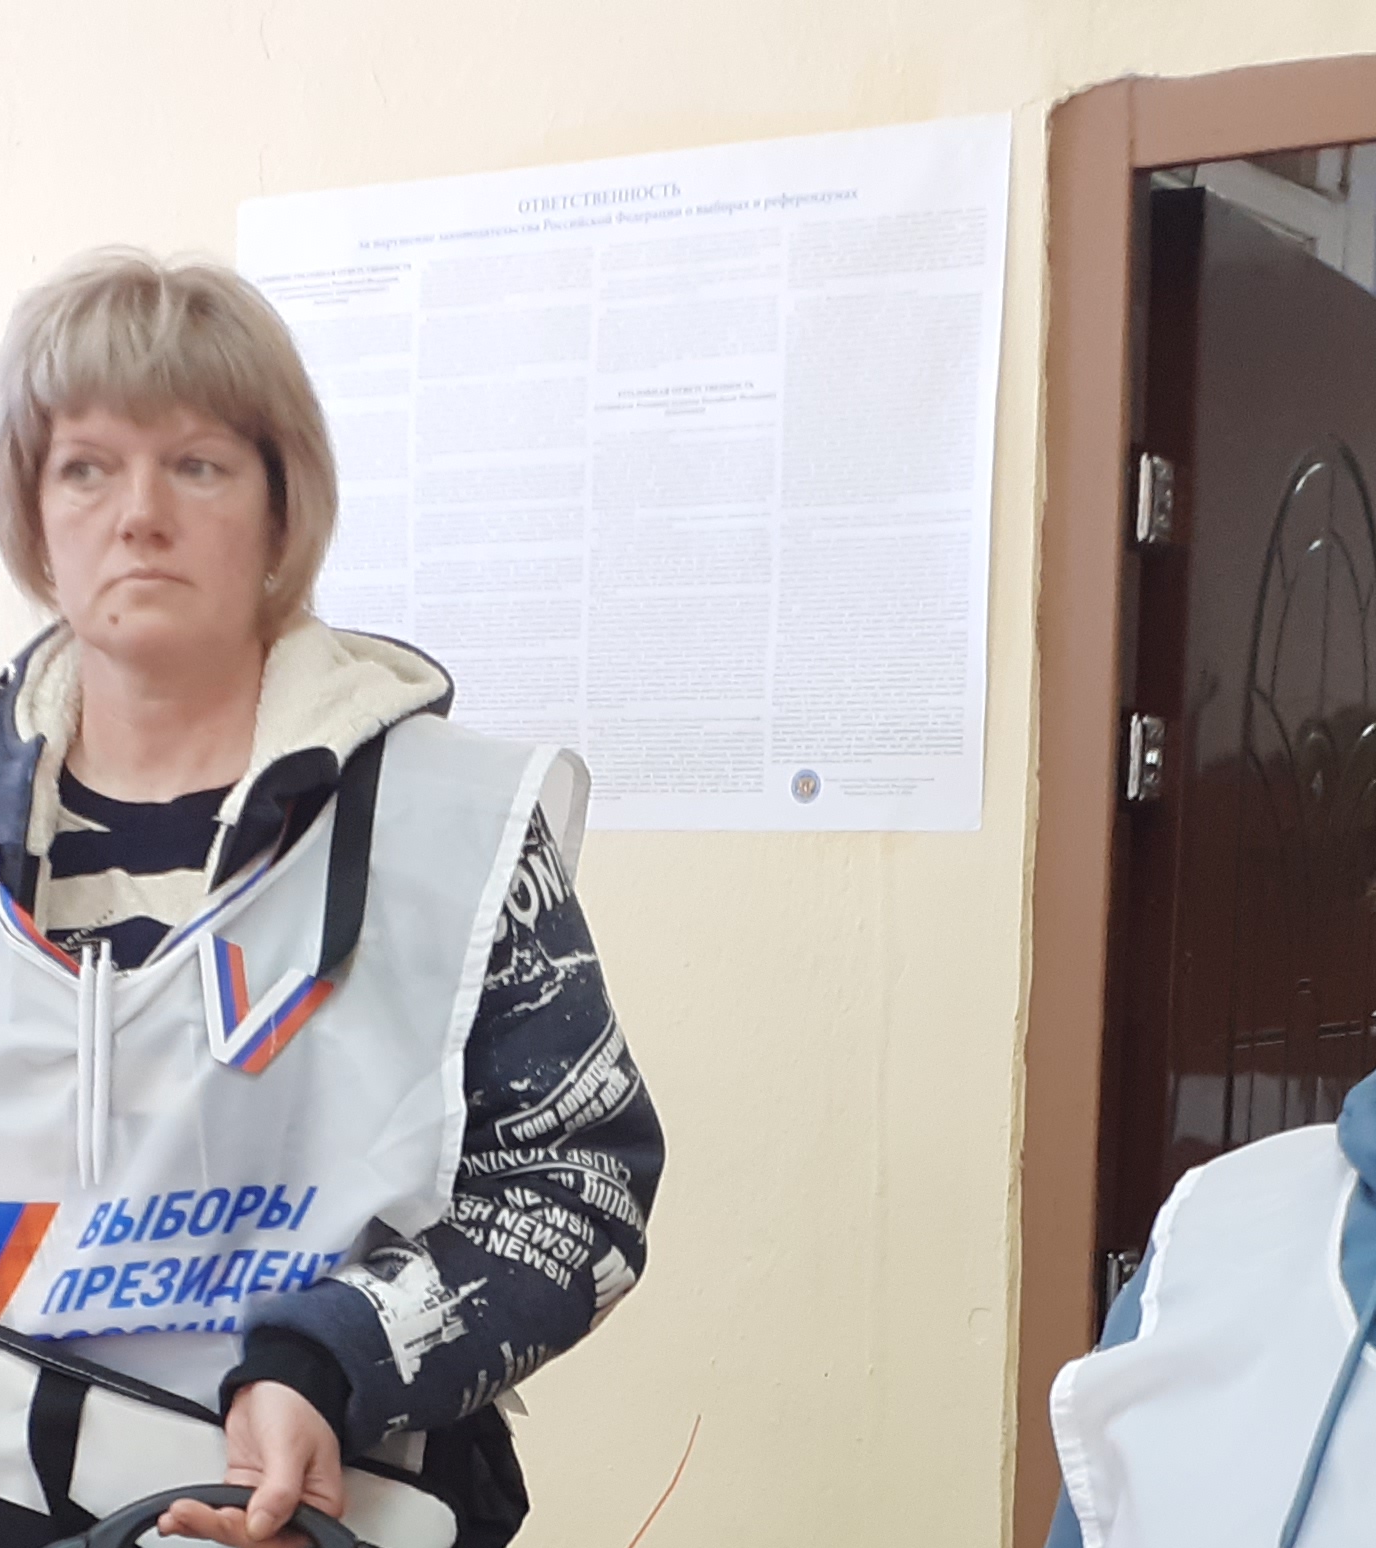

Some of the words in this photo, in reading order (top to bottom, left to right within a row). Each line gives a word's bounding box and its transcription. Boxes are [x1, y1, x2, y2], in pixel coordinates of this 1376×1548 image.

[517, 181, 682, 215] ОТВЕТСТВЕННОСТЬ
[76, 1184, 318, 1249] ВЫБОРЫ
[40, 1250, 347, 1315] ПРЕЗИДЕНТ
